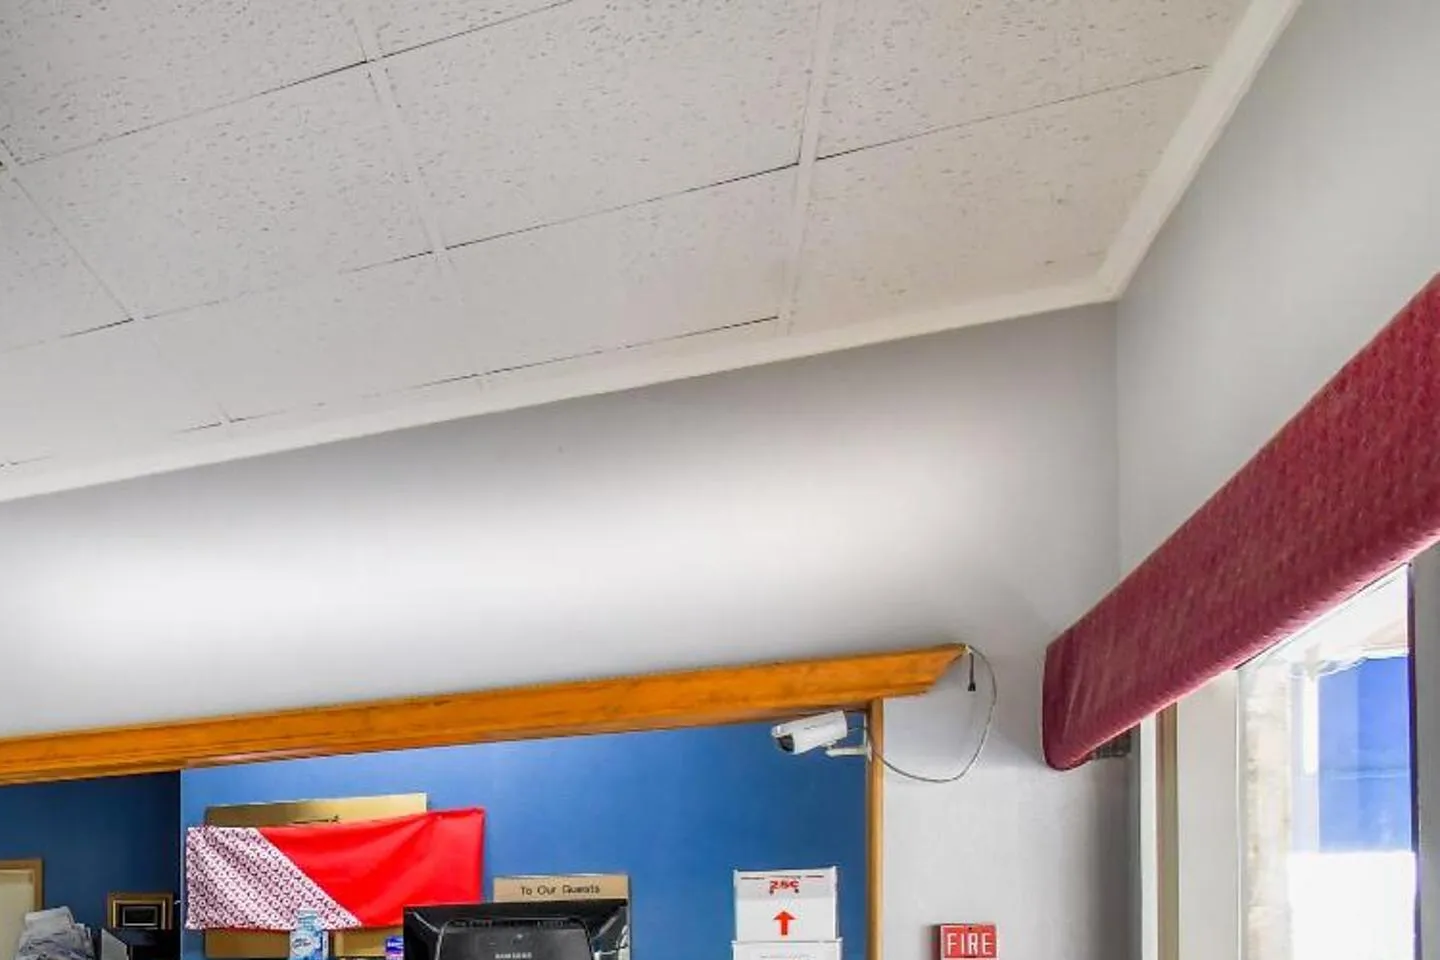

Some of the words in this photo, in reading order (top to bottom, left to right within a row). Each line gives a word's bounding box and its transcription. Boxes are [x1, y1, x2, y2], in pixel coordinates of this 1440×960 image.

[521, 886, 533, 896] To
[537, 884, 557, 895] Our
[562, 884, 601, 896] Guests
[947, 932, 993, 956] FIRE
